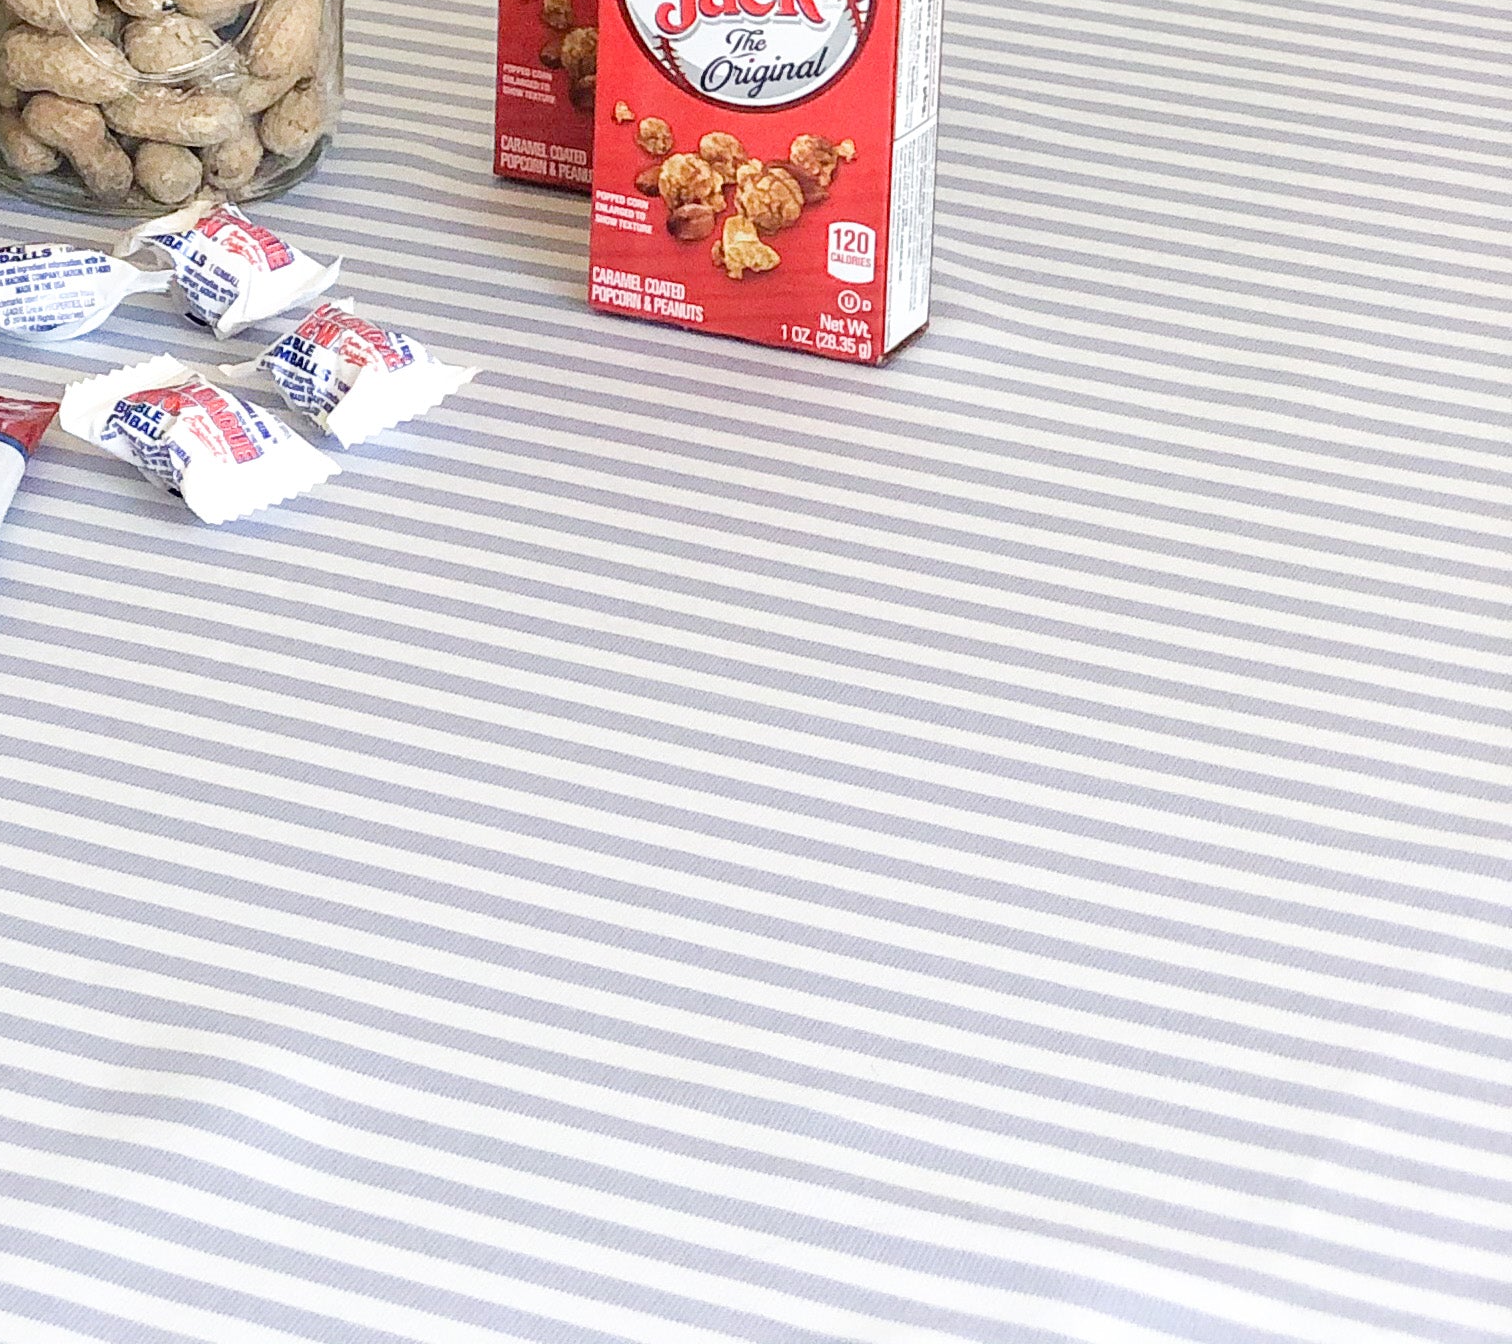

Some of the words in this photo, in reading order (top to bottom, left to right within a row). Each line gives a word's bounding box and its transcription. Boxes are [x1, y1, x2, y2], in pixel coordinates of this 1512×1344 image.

[726, 28, 766, 54] The
[701, 47, 828, 98] Original
[501, 135, 547, 158] CARAMEL
[550, 145, 587, 165] COATED
[501, 153, 546, 174] POPCORN
[834, 228, 869, 254] 120
[830, 252, 871, 268] CALORIES
[593, 266, 643, 292] CARAMEL
[645, 278, 685, 300] COATED
[592, 284, 641, 309] POPCORN
[644, 296, 651, 311] &
[654, 297, 703, 322] PEANUTS
[820, 313, 844, 333] Net
[847, 318, 871, 338] Wt.
[781, 324, 788, 341] 1
[859, 340, 872, 359] g)
